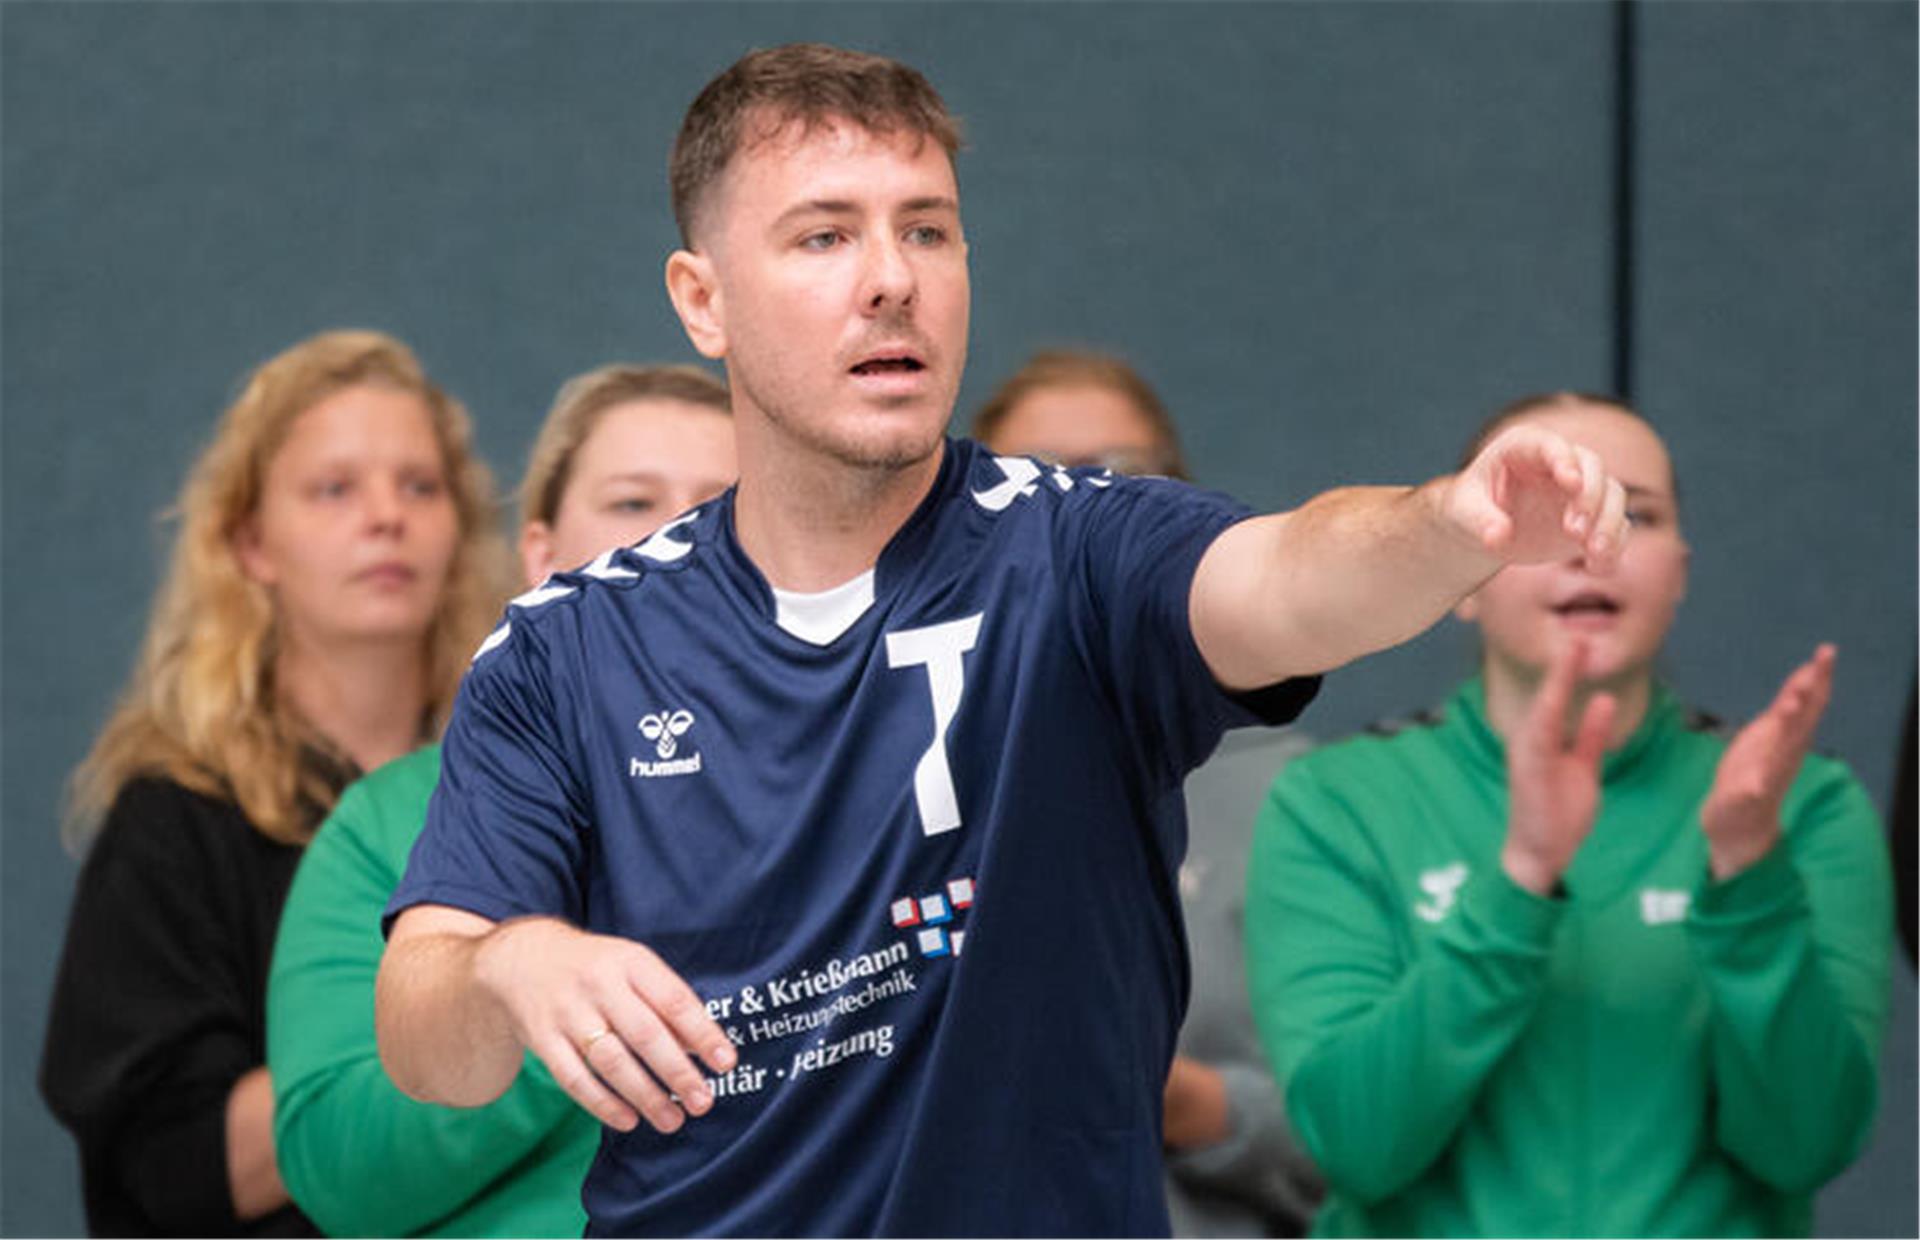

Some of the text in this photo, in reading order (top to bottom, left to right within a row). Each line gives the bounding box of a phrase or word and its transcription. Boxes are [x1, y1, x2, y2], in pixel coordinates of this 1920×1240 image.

[630, 752, 701, 777] hummel
[704, 994, 734, 1021] er
[739, 985, 765, 1015] &
[727, 1026, 745, 1046] &
[703, 1063, 768, 1098] nitär
